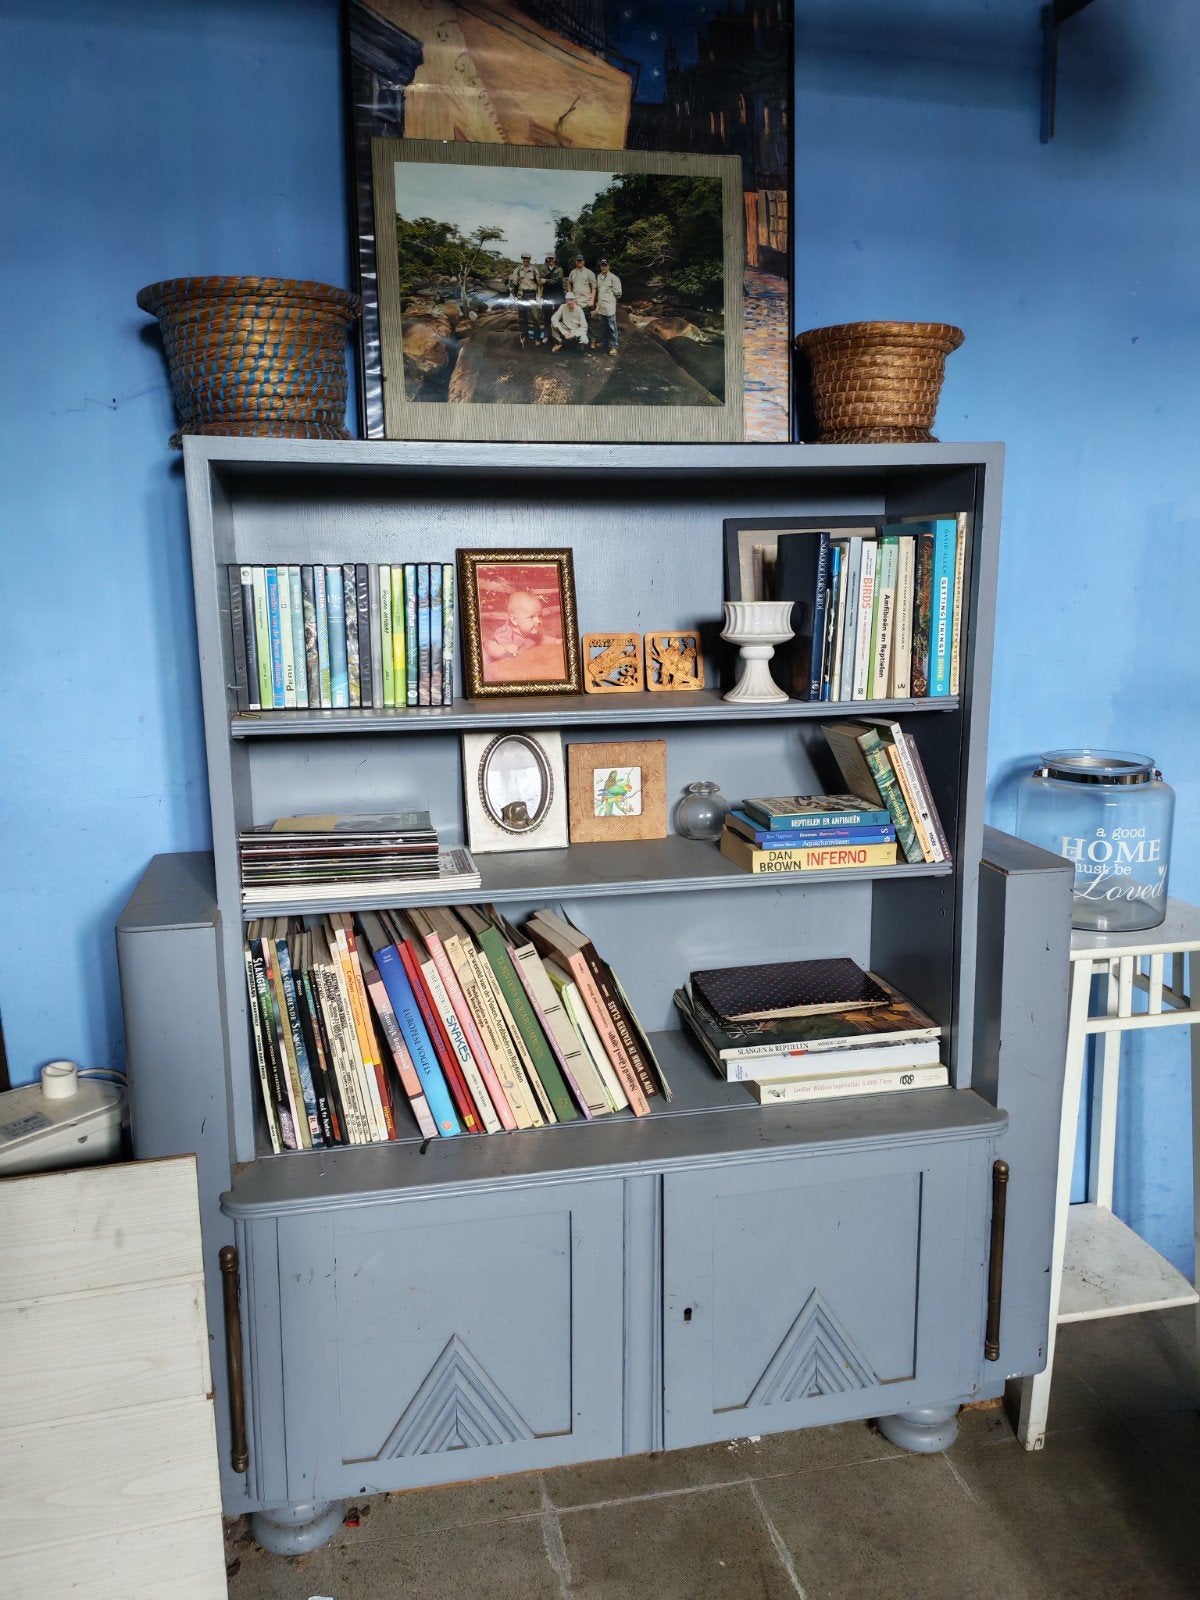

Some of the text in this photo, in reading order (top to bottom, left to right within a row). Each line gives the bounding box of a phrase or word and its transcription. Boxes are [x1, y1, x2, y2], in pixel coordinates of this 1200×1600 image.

[862, 577, 873, 609] BIRDS
[882, 594, 890, 631] Amfibieën
[882, 633, 886, 642] en
[878, 644, 886, 678] Reptielen
[791, 818, 820, 828] REPTIELEN
[822, 817, 830, 825] EN
[1096, 826, 1146, 840] a good
[759, 860, 802, 872] BROWN
[768, 851, 793, 862] DAN
[806, 849, 868, 867] INFERNO
[1060, 836, 1162, 863] HOME
[1073, 864, 1168, 902] Loved
[1114, 864, 1132, 876] be
[247, 960, 257, 998] AMPHIBIANS
[254, 957, 268, 994] SLANGEN
[296, 980, 304, 996] Discus
[282, 968, 297, 1022] FASCINERENDE
[292, 1022, 305, 1056] SLANGEN
[380, 1003, 397, 1037] Natuurlijk
[468, 948, 526, 1083] De wereld van de Vissen, Amfibieën en Reptielen
[403, 1008, 422, 1046] EUROPESE
[417, 1046, 432, 1075] VOGELS
[446, 1014, 472, 1063] SNAKES
[607, 1000, 654, 1095] HOW TO WORK IN STAINED GLASS
[737, 1047, 767, 1056] SLANGEN
[774, 1042, 808, 1052] REPTIELEN
[605, 1031, 638, 1093] Stained Glass Lamps
[319, 1097, 327, 1112] Back
[323, 1118, 332, 1138] Nature
